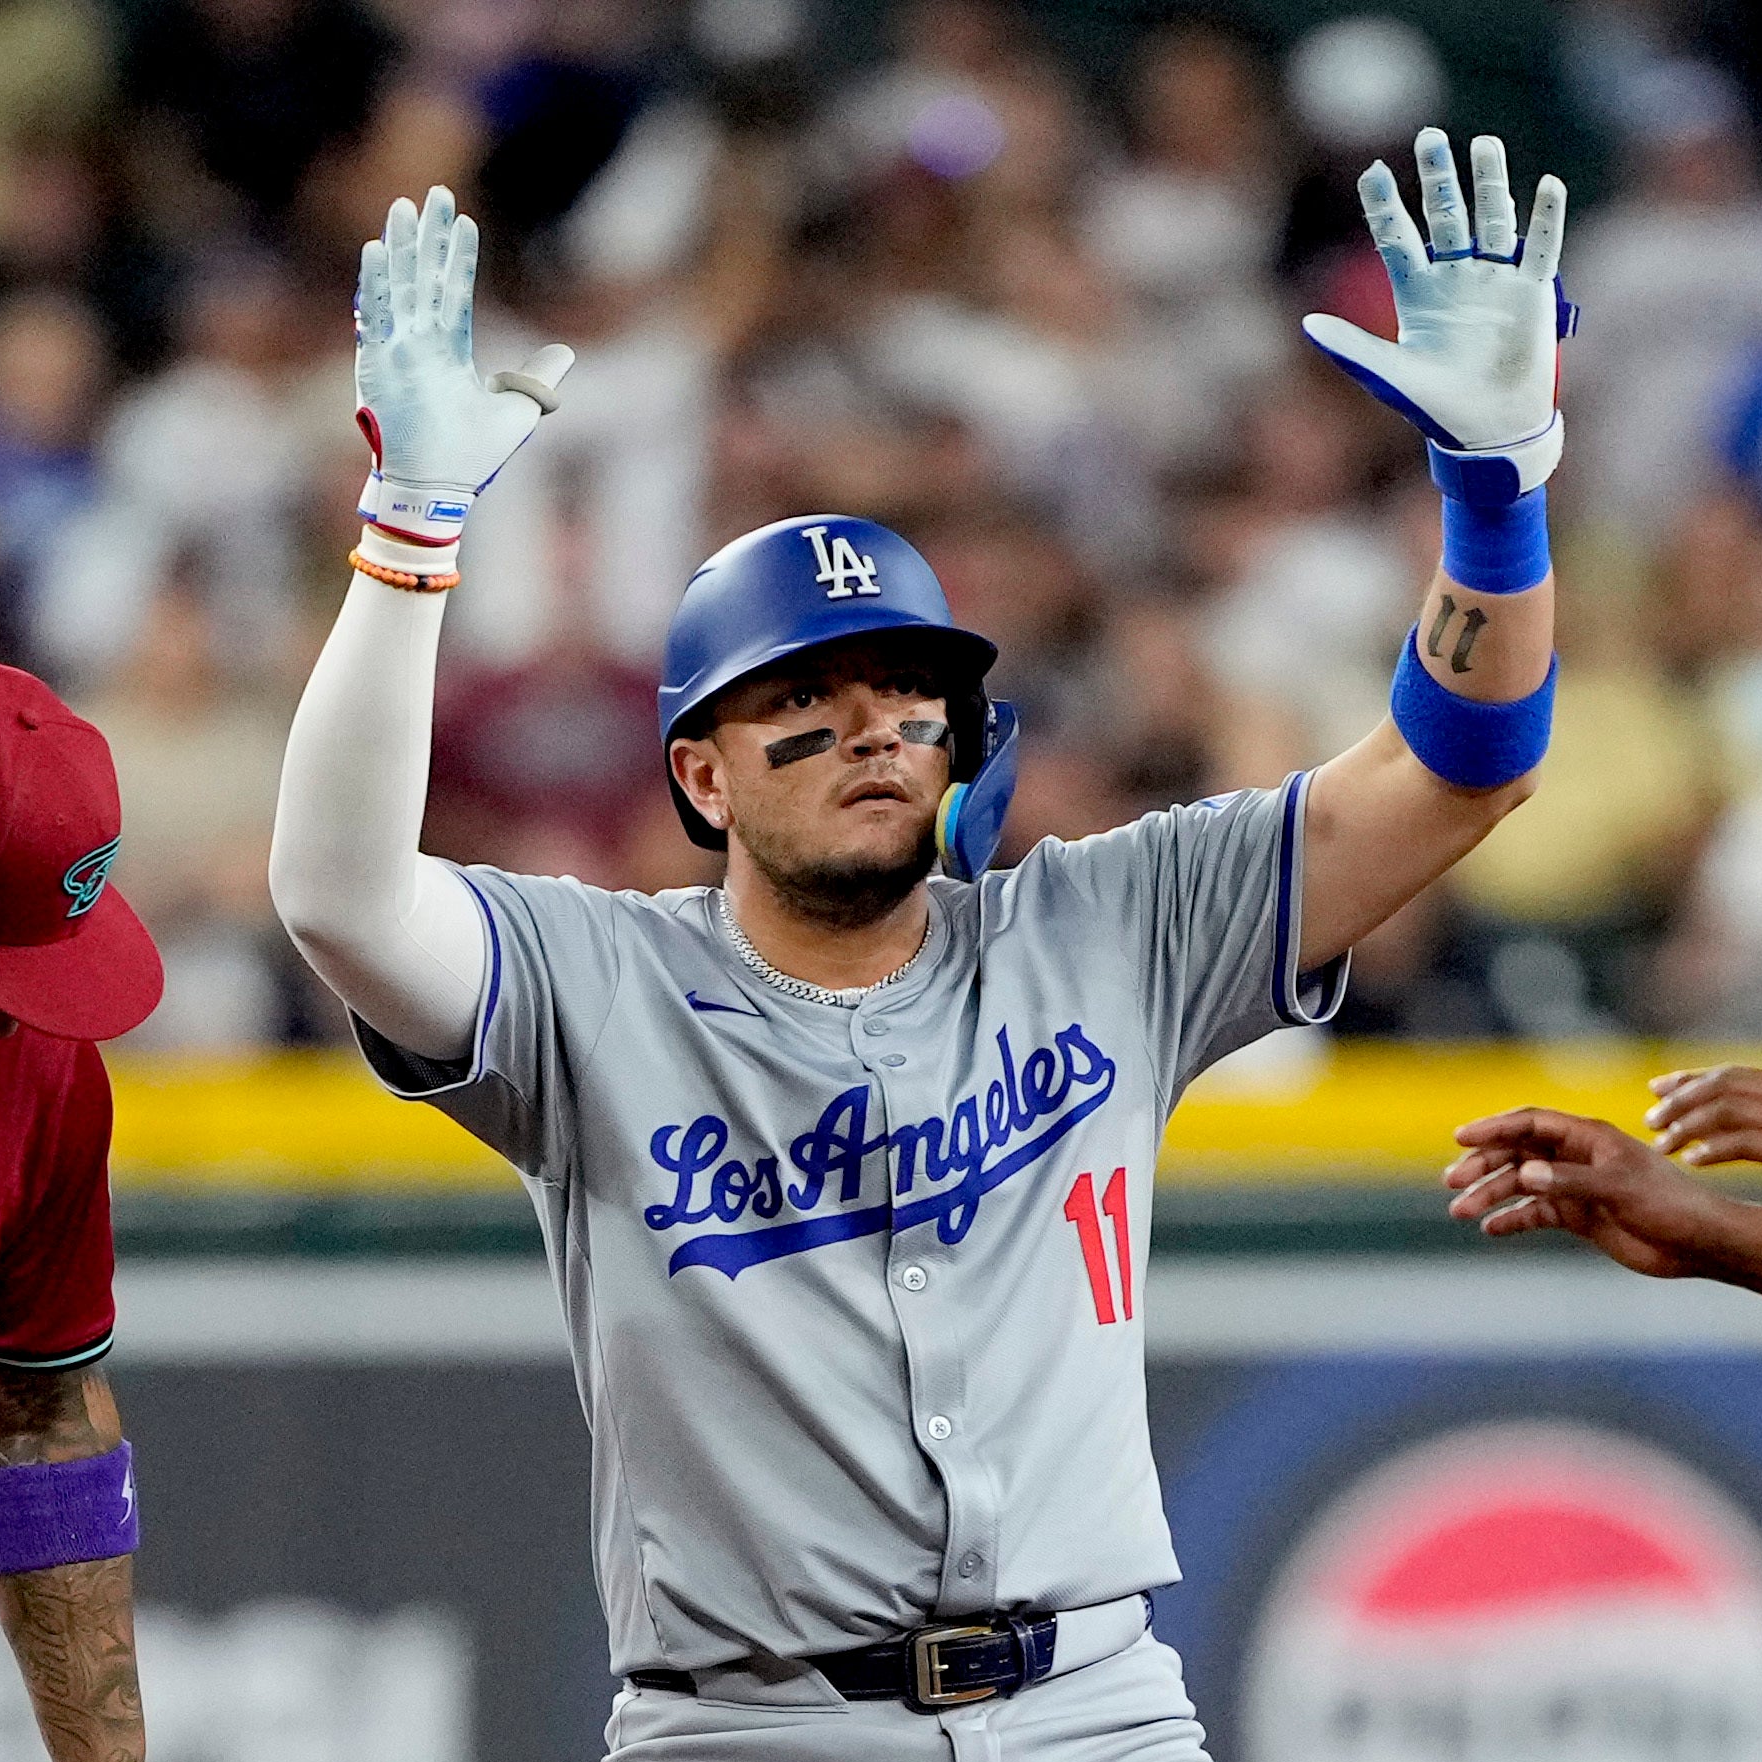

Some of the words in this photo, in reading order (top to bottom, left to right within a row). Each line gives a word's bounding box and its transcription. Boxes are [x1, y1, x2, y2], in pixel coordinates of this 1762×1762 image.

[801, 526, 881, 599] LA
[644, 1115, 781, 1231] Los
[789, 1024, 1115, 1245] Angeles
[1063, 1167, 1134, 1325] 11
